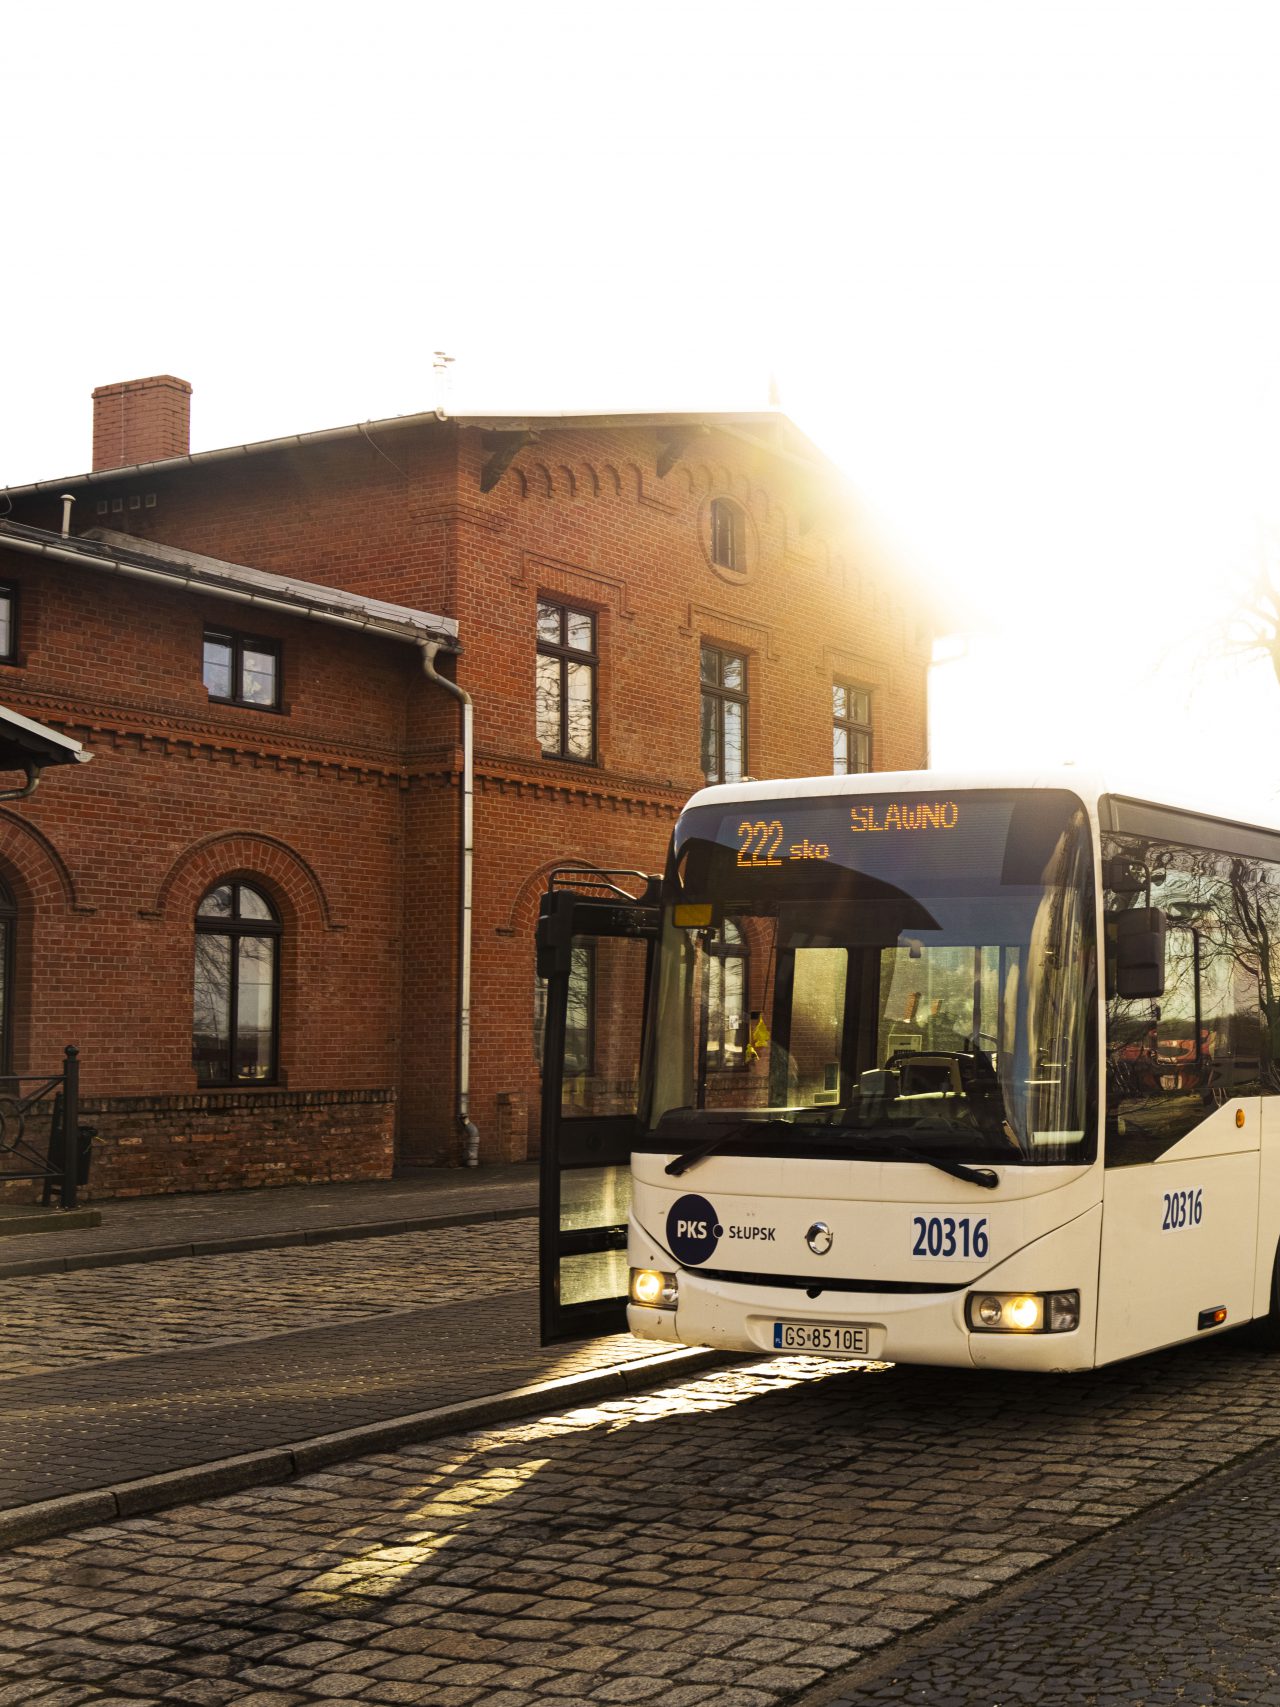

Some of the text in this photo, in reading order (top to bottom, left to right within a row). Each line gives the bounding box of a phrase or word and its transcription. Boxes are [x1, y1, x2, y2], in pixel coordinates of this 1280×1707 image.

[737, 821, 830, 867] 222 sko
[1162, 1188, 1202, 1230] 20316
[677, 1220, 776, 1241] PKS SŁUPSK
[912, 1217, 988, 1257] 20316
